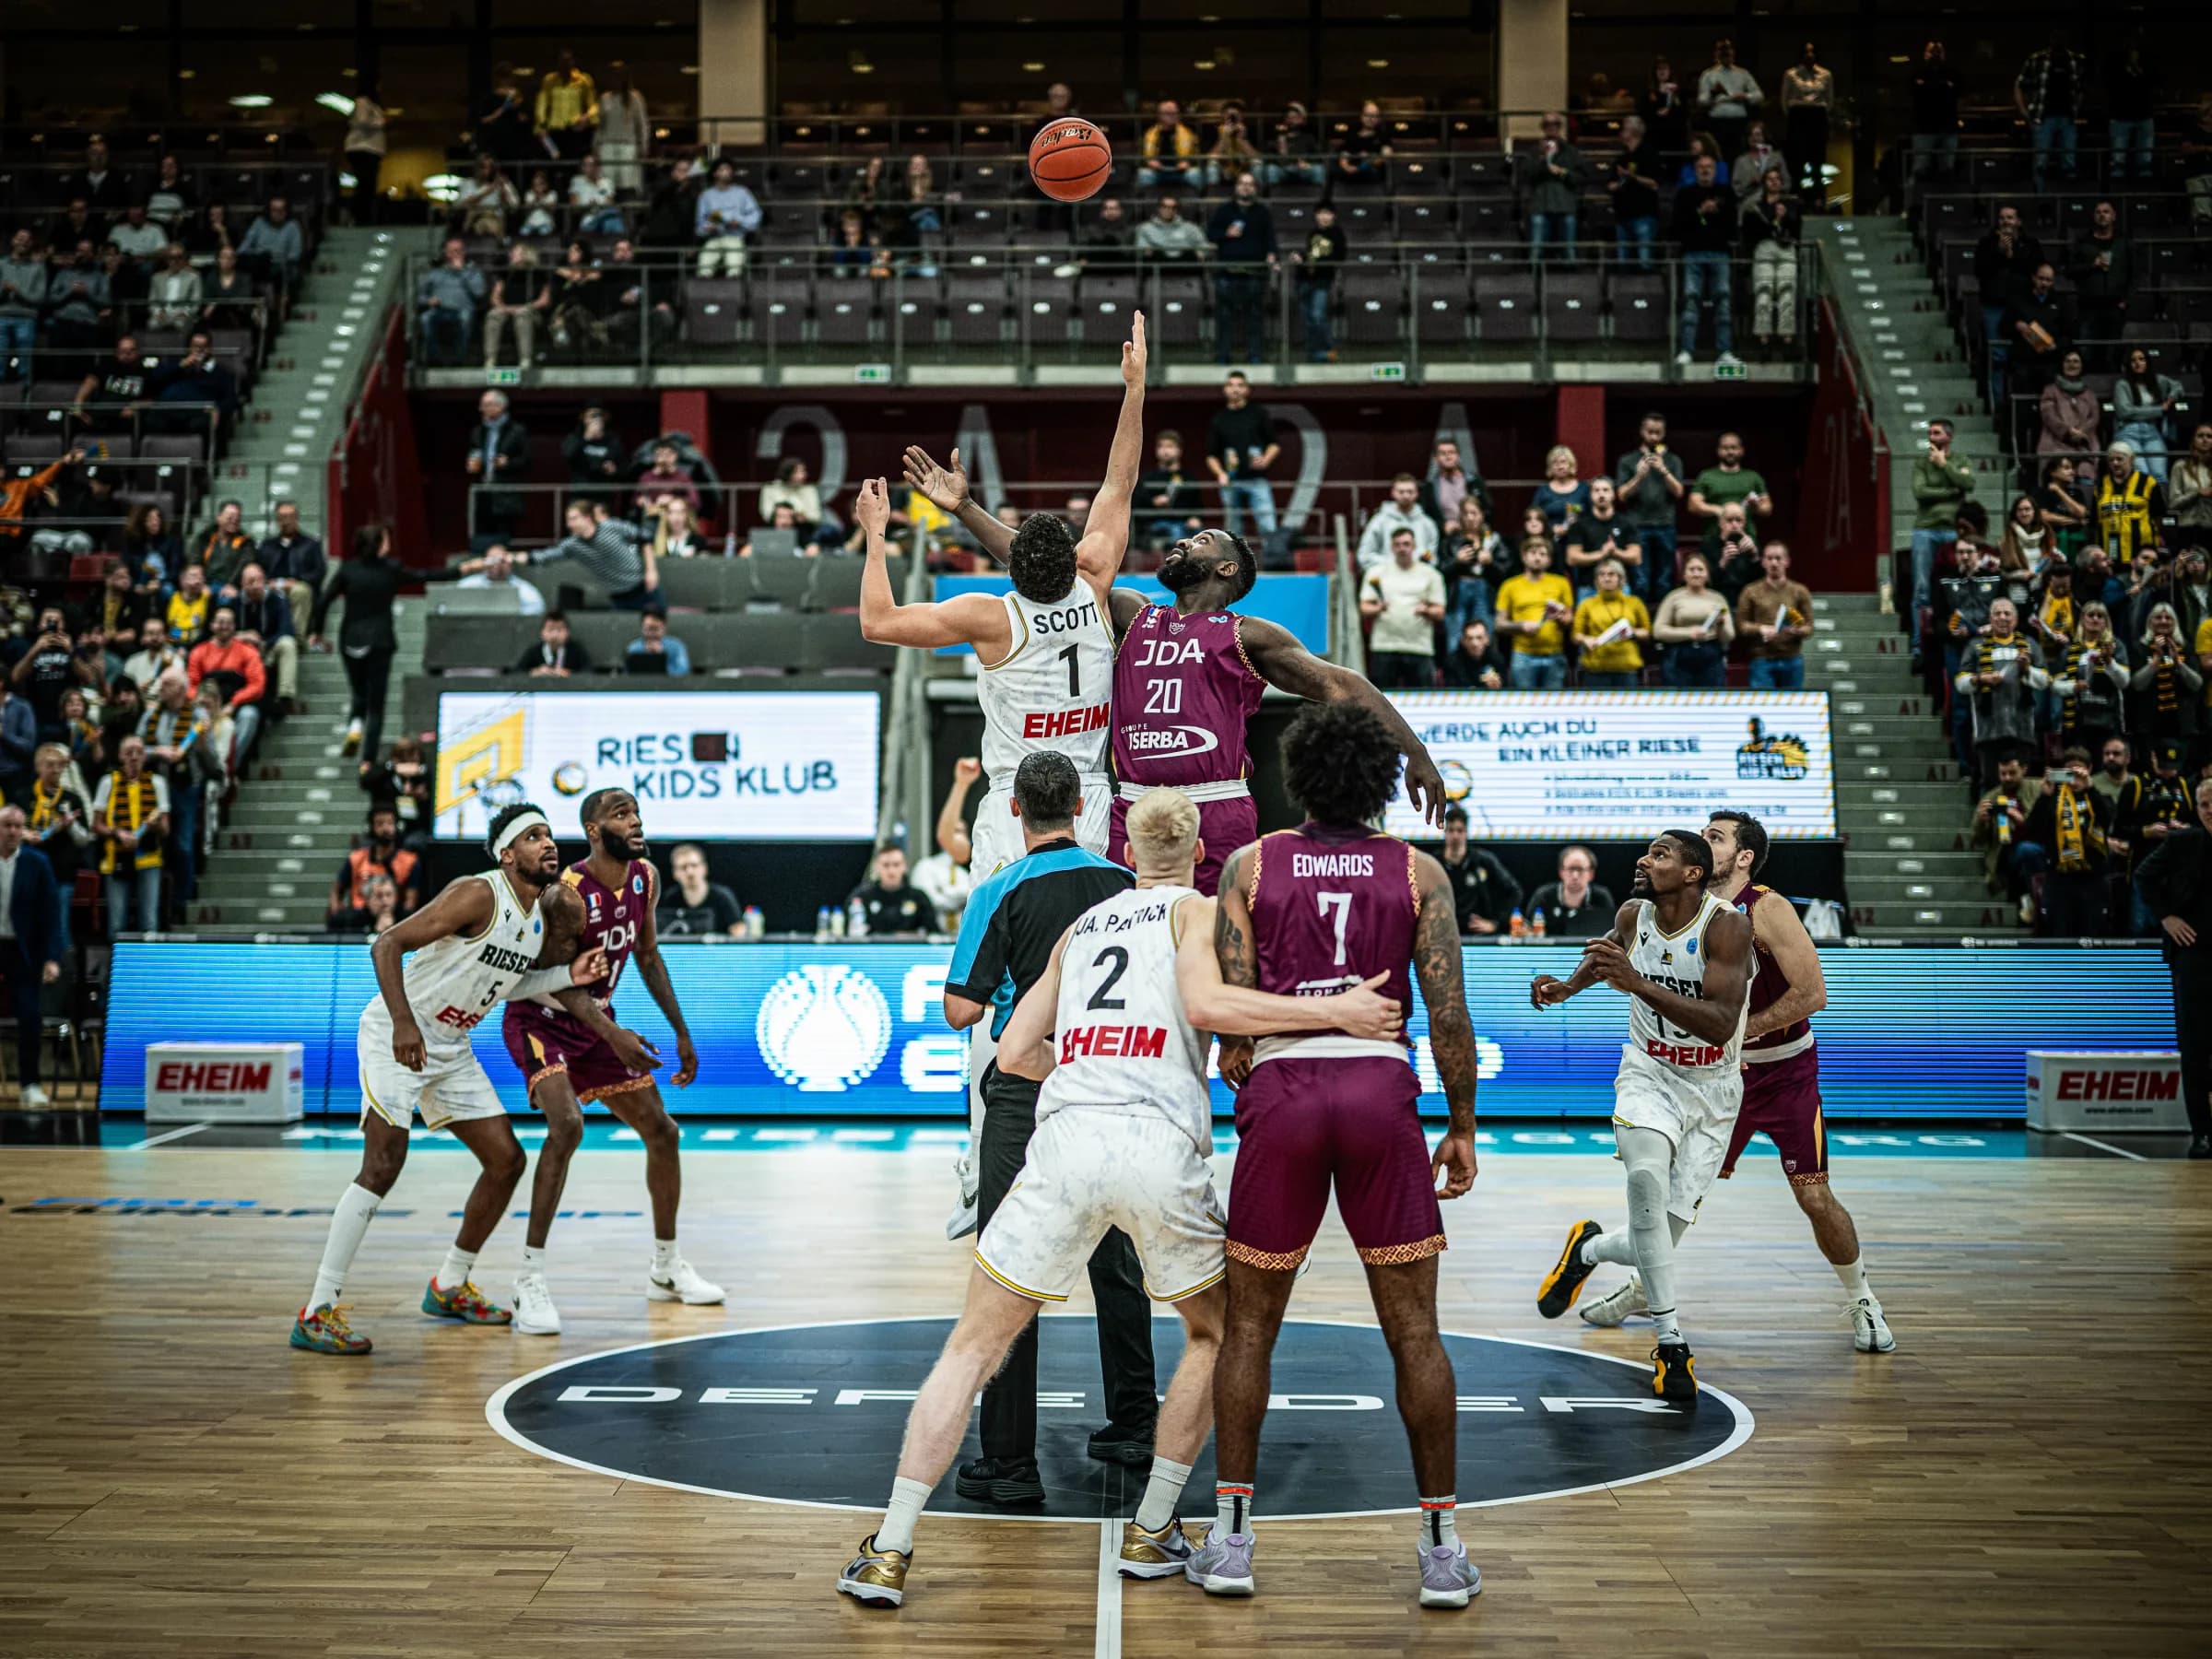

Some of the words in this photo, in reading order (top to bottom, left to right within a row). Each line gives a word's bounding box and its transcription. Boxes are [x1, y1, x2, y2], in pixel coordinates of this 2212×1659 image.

[1033, 602, 1099, 634] SCOTT
[1135, 638, 1206, 667] JDA
[1877, 637, 1897, 654] A1
[1059, 642, 1080, 698] 1
[1144, 678, 1182, 714] 20
[1899, 699, 1920, 715] A1
[1022, 702, 1110, 738] EHEIM
[1499, 721, 1559, 740] AUCH
[1567, 719, 1597, 735] DU
[597, 733, 739, 766] RIESN
[1499, 747, 1533, 763] EIN
[1540, 740, 1630, 762] KLEINER
[1639, 736, 1700, 755] RIESE
[634, 769, 722, 799] KIDS
[737, 760, 838, 796] KLUB
[1292, 853, 1374, 878] EDWARDS
[596, 919, 636, 951] JDA
[1076, 913, 1099, 936] JA.
[1317, 891, 1353, 966] 7
[481, 980, 503, 1006] 5
[1087, 946, 1129, 1010] 2
[1652, 1011, 1691, 1039] 1
[1060, 1025, 1168, 1065] EHEIM
[1647, 1039, 1724, 1067] EHEIM
[156, 1061, 273, 1093] EHEIM
[2056, 1070, 2181, 1101] EHEIM
[557, 1384, 1684, 1414] DEFEDER
